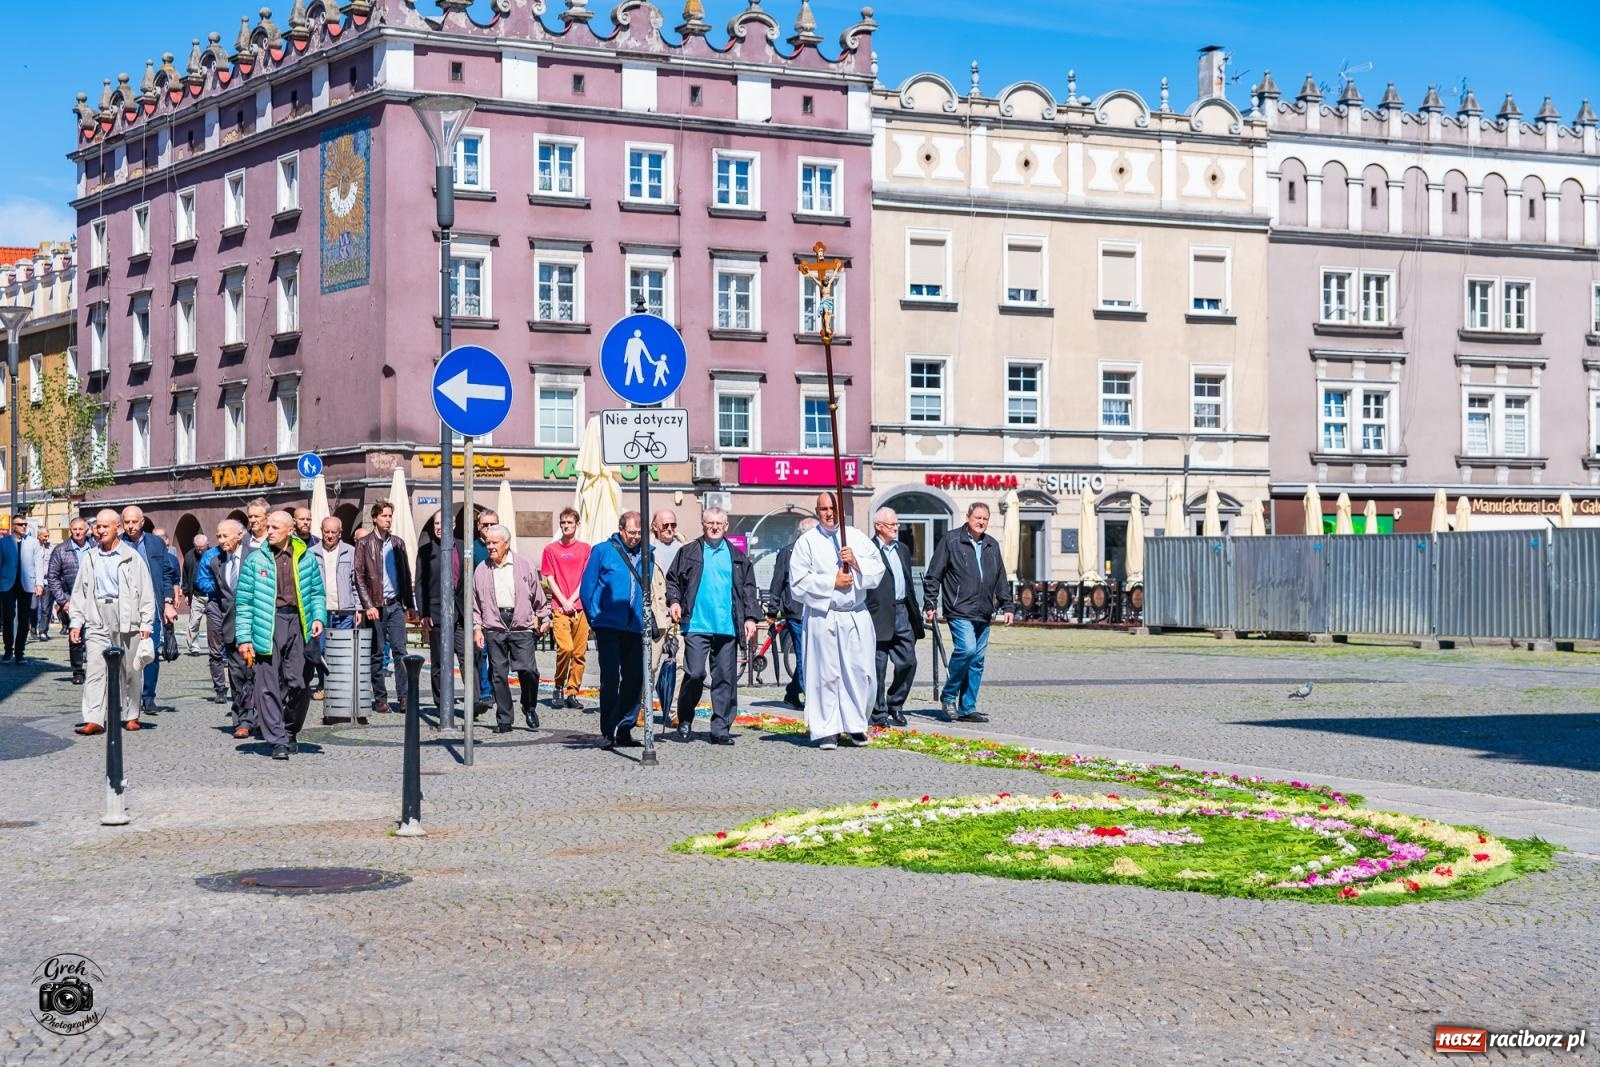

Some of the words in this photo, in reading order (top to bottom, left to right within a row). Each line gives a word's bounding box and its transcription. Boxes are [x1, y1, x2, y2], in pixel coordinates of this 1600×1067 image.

[605, 413, 628, 425] Nie
[634, 413, 684, 428] dotyczy
[211, 462, 279, 488] TABAC
[925, 473, 1019, 488] RESTAURACJA
[1046, 473, 1105, 492] SHIRO
[1472, 497, 1538, 513] Manufaktura
